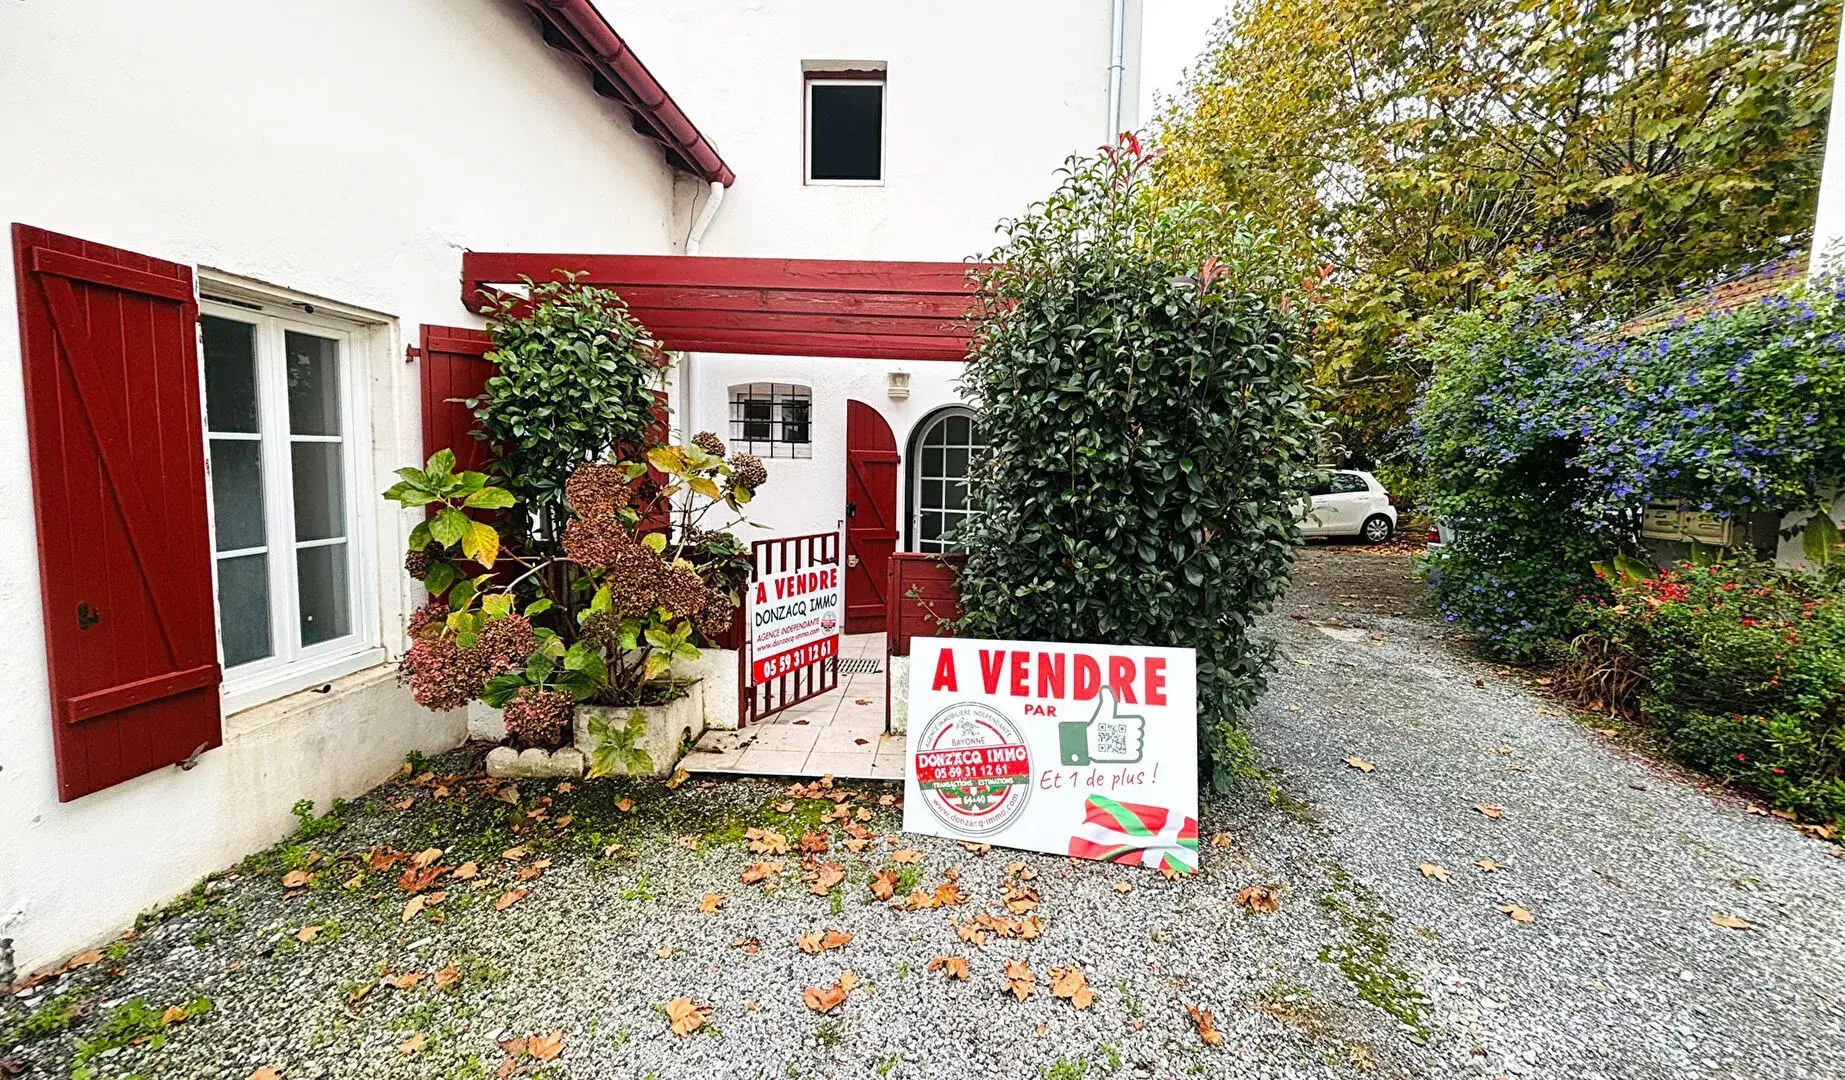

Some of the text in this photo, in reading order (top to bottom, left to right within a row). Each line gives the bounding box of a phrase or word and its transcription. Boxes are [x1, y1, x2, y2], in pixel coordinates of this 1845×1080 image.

[756, 568, 837, 605] A VENDRE
[755, 602, 806, 627] DONZACQ
[810, 593, 837, 612] IMMO
[757, 629, 780, 643] AGENCE
[763, 640, 831, 678] 05 59 31 12 61
[932, 648, 1167, 706] A VENDRE
[1024, 704, 1057, 717] PAR
[952, 737, 985, 747] BAYONNE
[919, 747, 1026, 768] DONZACQ IMMO
[934, 769, 947, 779] 05
[965, 766, 976, 777] 31
[981, 764, 993, 775] 12
[995, 763, 1008, 775] 61
[1040, 770, 1061, 790] Et
[1069, 771, 1078, 788] 1
[1086, 768, 1104, 787] de
[1112, 768, 1144, 791] plus
[932, 778, 1014, 788] TRANSACTIONS ESTIMATIONS
